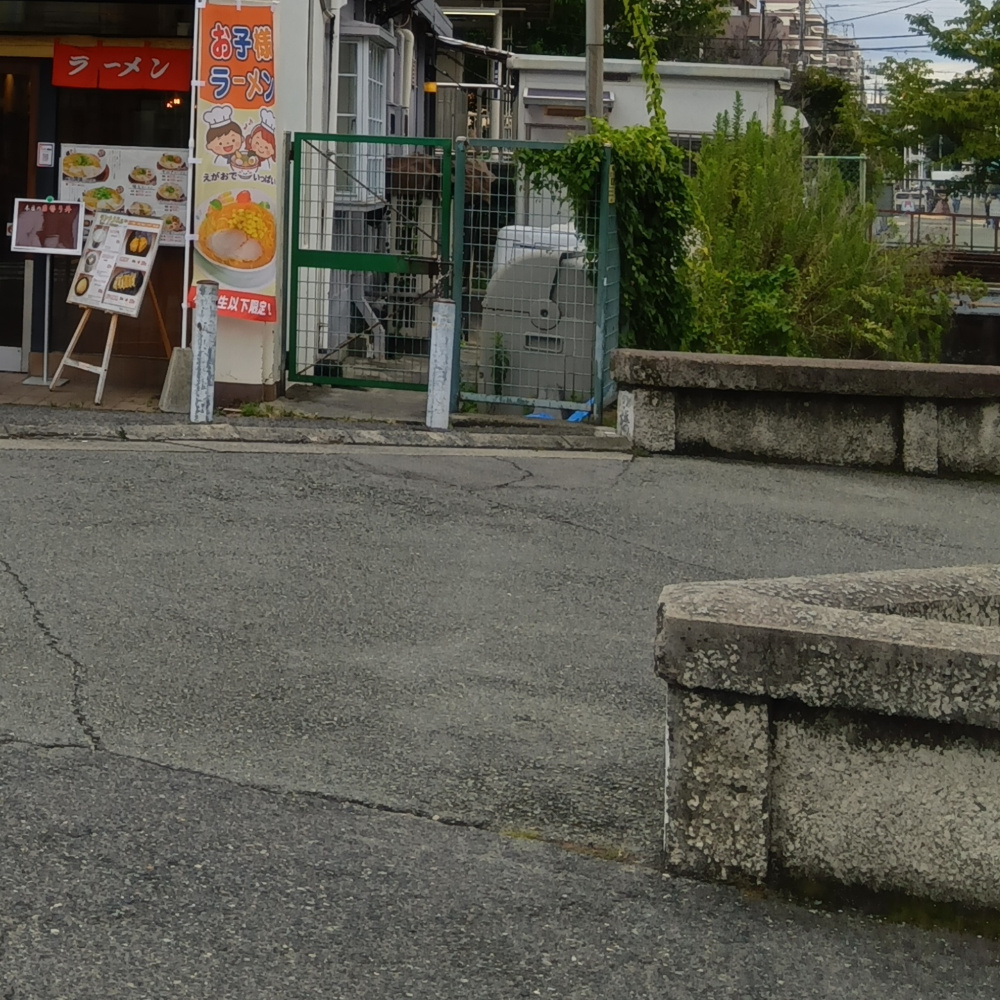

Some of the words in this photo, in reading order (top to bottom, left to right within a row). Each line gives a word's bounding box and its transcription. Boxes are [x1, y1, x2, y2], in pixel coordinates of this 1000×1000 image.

[210, 22, 273, 61] お子様
[67, 54, 170, 80] ラーメン
[209, 65, 275, 103] ラーメン
[203, 171, 237, 183] えがおで
[193, 295, 272, 316] 生以下限定!
